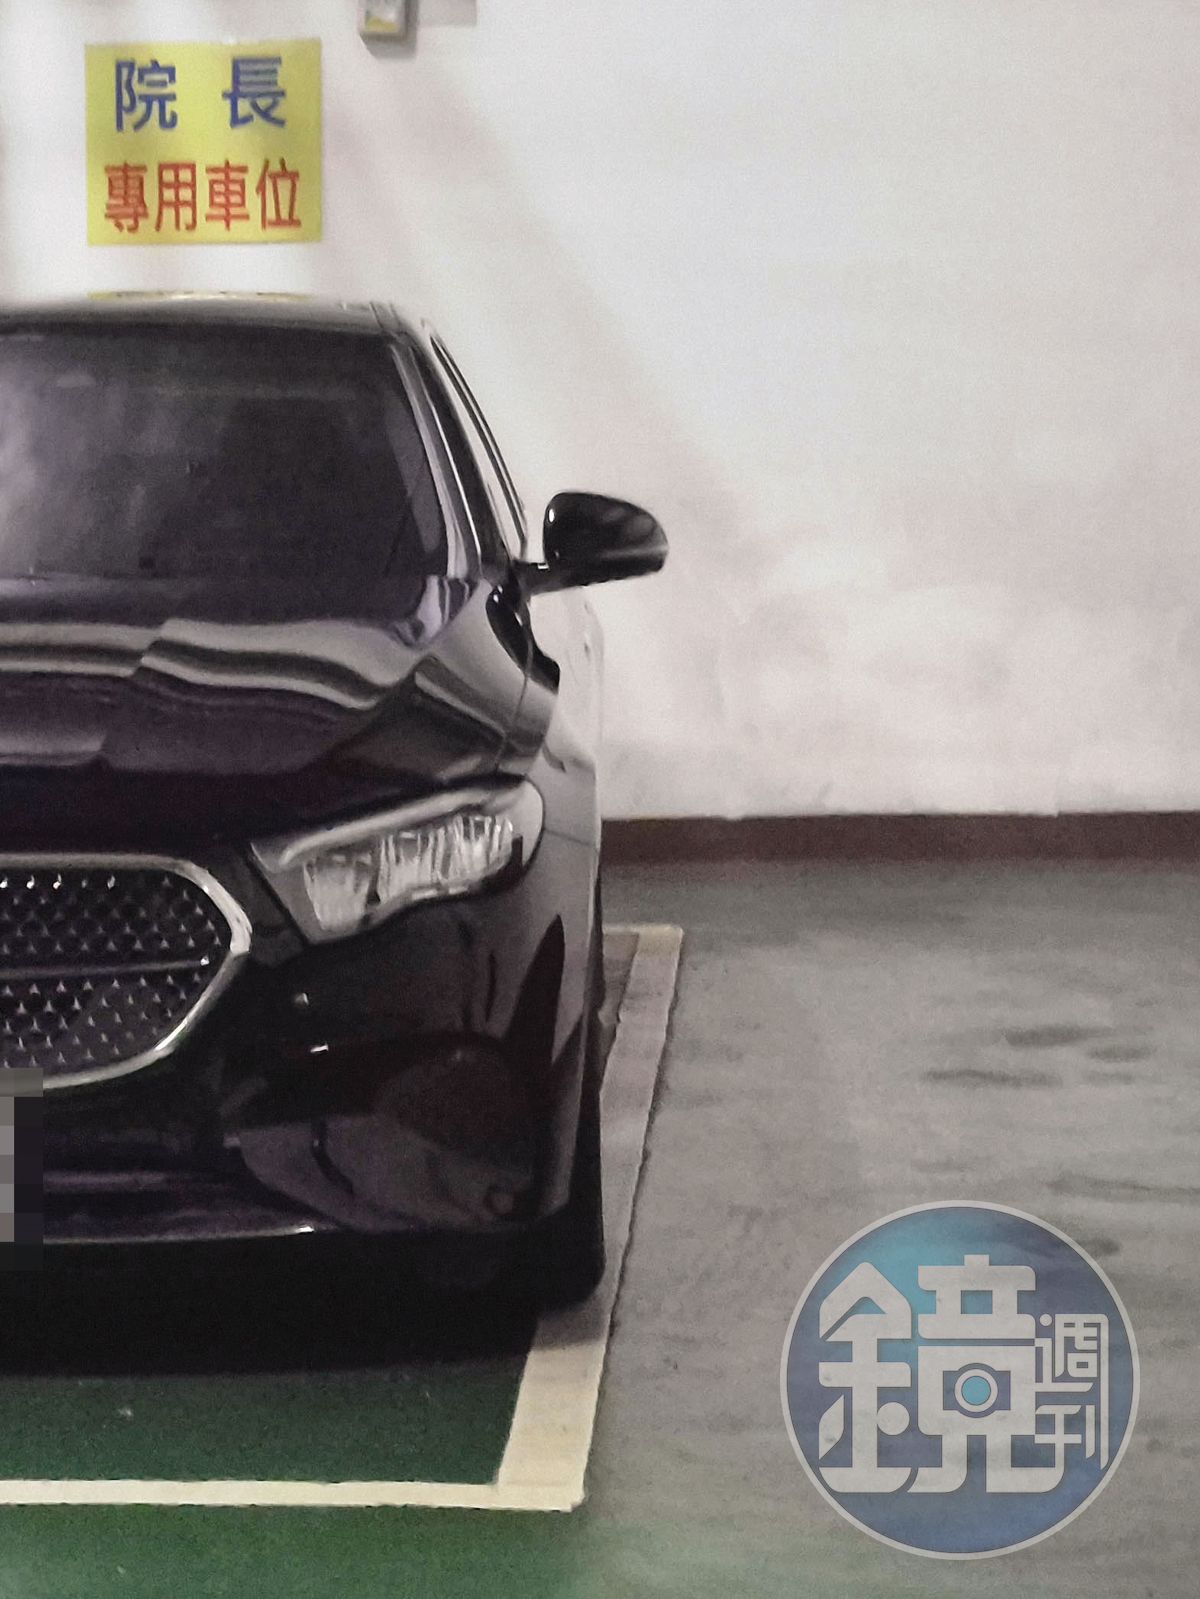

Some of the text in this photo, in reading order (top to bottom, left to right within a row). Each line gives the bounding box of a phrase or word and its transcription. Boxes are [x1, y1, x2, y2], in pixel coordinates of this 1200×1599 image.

[114, 57, 287, 132] 院長
[104, 158, 302, 233] 專用車位
